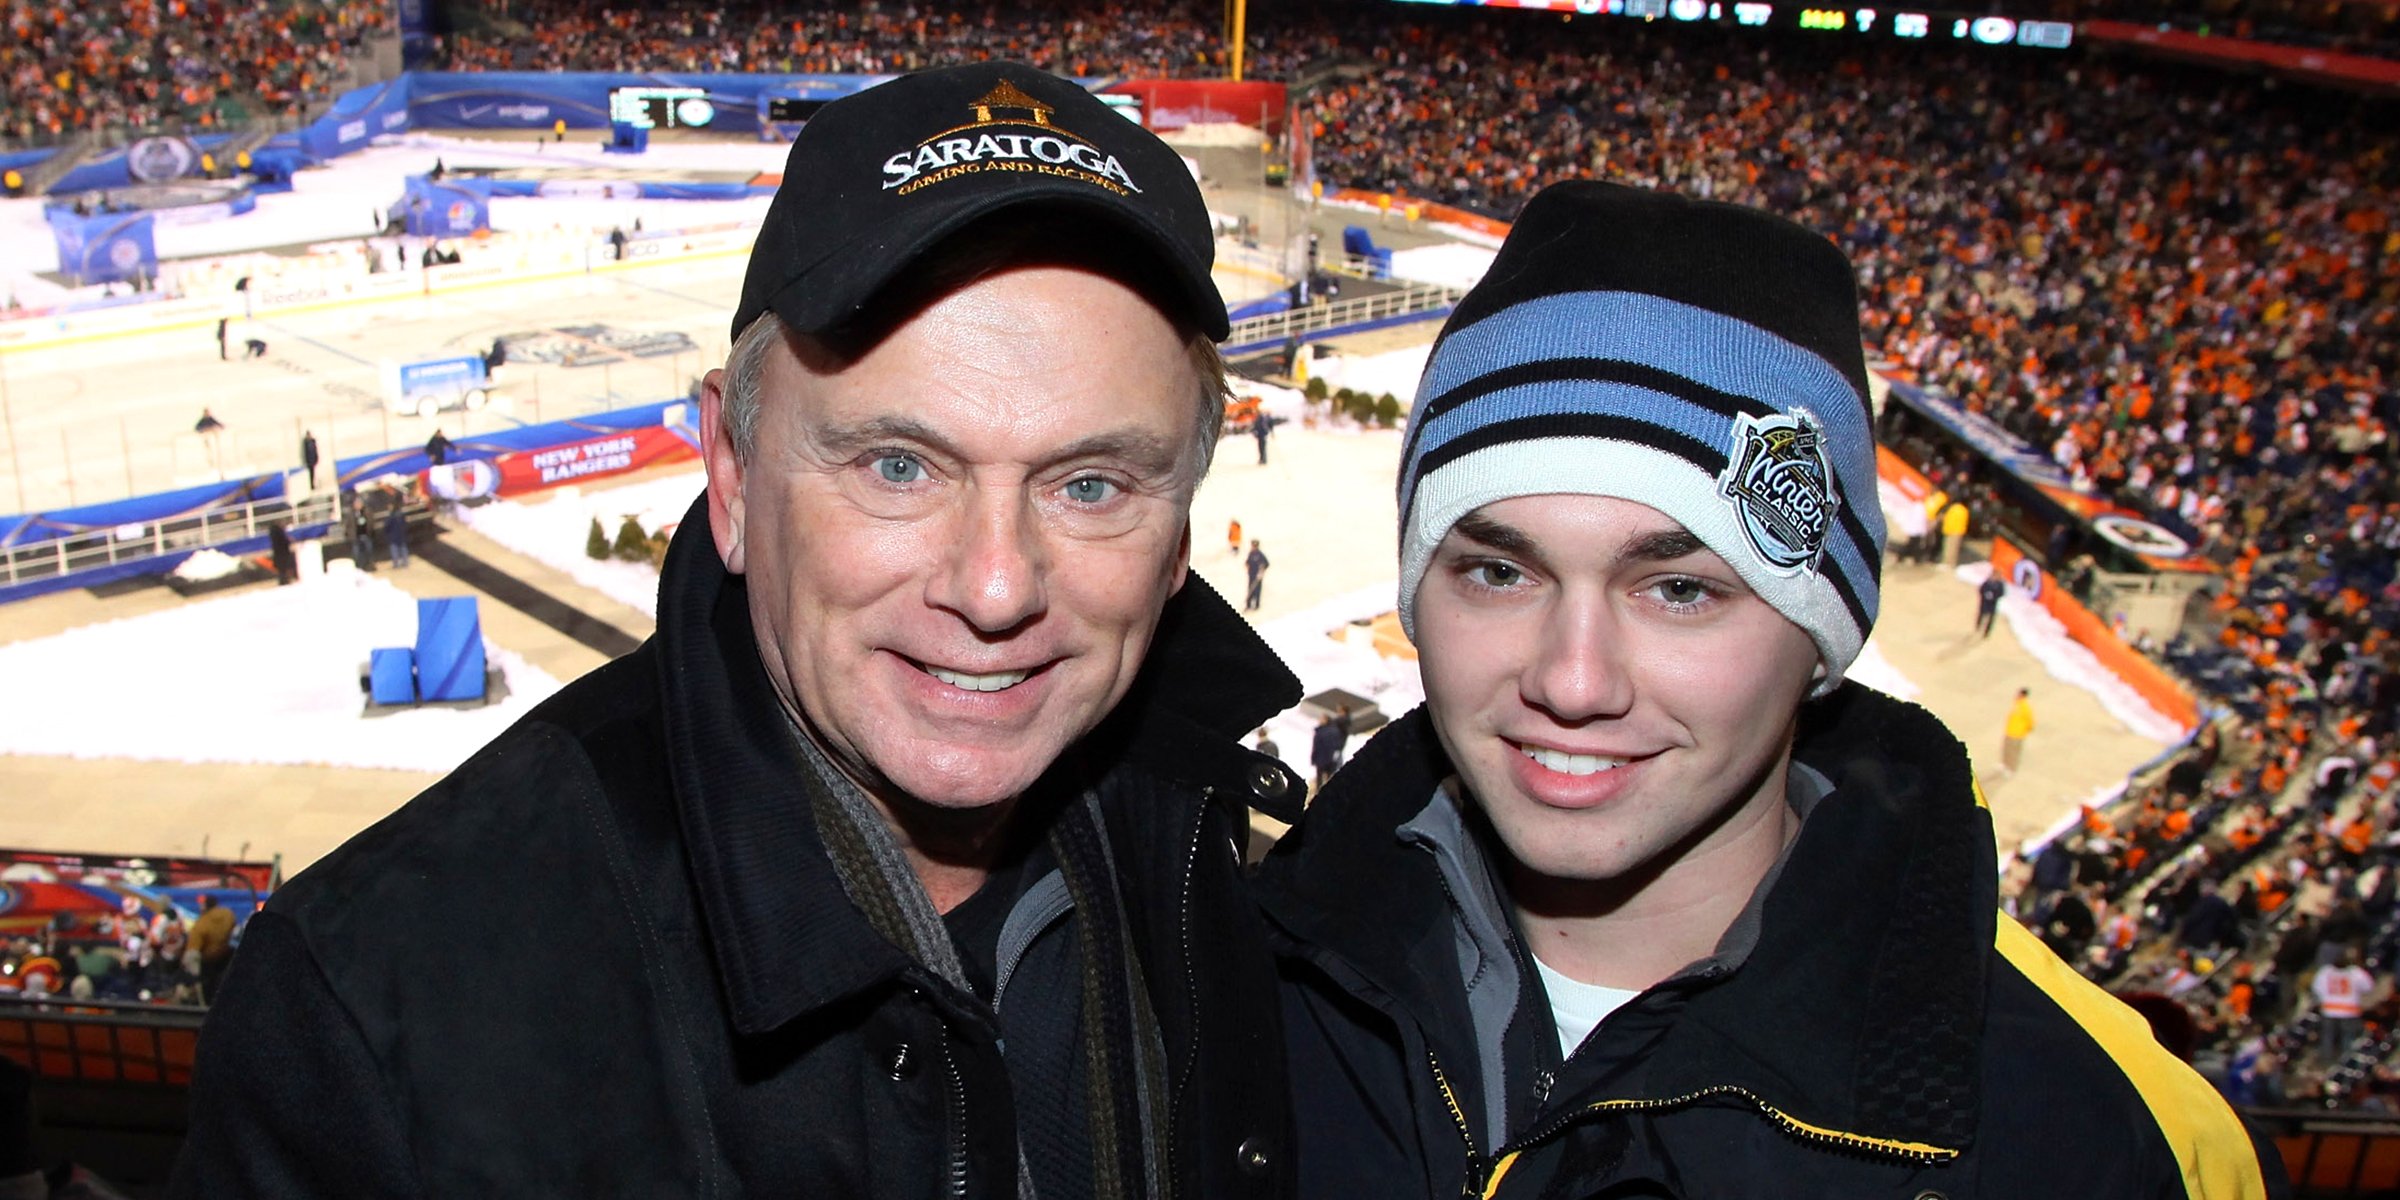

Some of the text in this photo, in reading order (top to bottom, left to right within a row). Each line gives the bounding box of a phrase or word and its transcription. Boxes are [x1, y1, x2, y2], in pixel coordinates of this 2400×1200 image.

[882, 134, 1143, 194] SARATOGA
[898, 161, 1130, 197] GAMING AND RACEWAY
[532, 436, 637, 469] NEW YORK
[541, 452, 632, 483] RANGERS
[1745, 435, 1824, 532] Winter
[1752, 481, 1811, 539] CLASSIC
